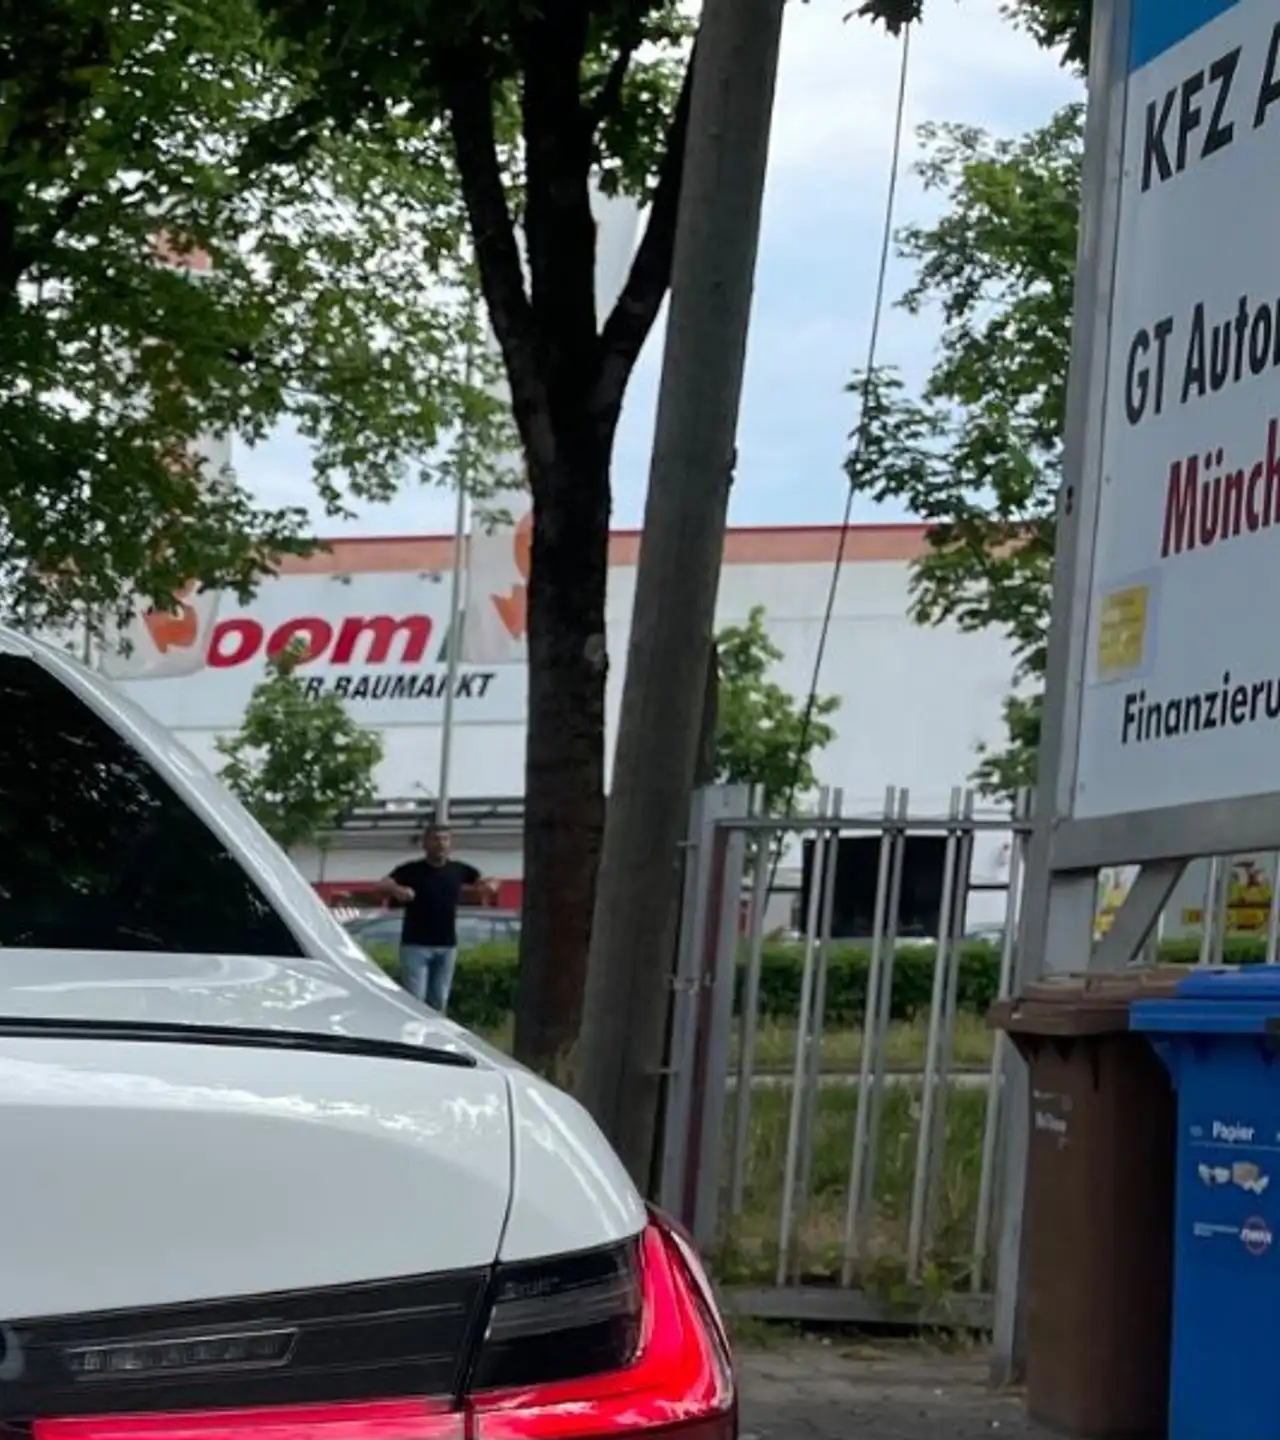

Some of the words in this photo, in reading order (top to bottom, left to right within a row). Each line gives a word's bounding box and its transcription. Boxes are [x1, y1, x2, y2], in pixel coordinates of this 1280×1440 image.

[1141, 45, 1242, 193] KFZ
[1125, 316, 1174, 425] GT
[206, 613, 433, 668] oom
[1213, 1120, 1255, 1142] Papier
